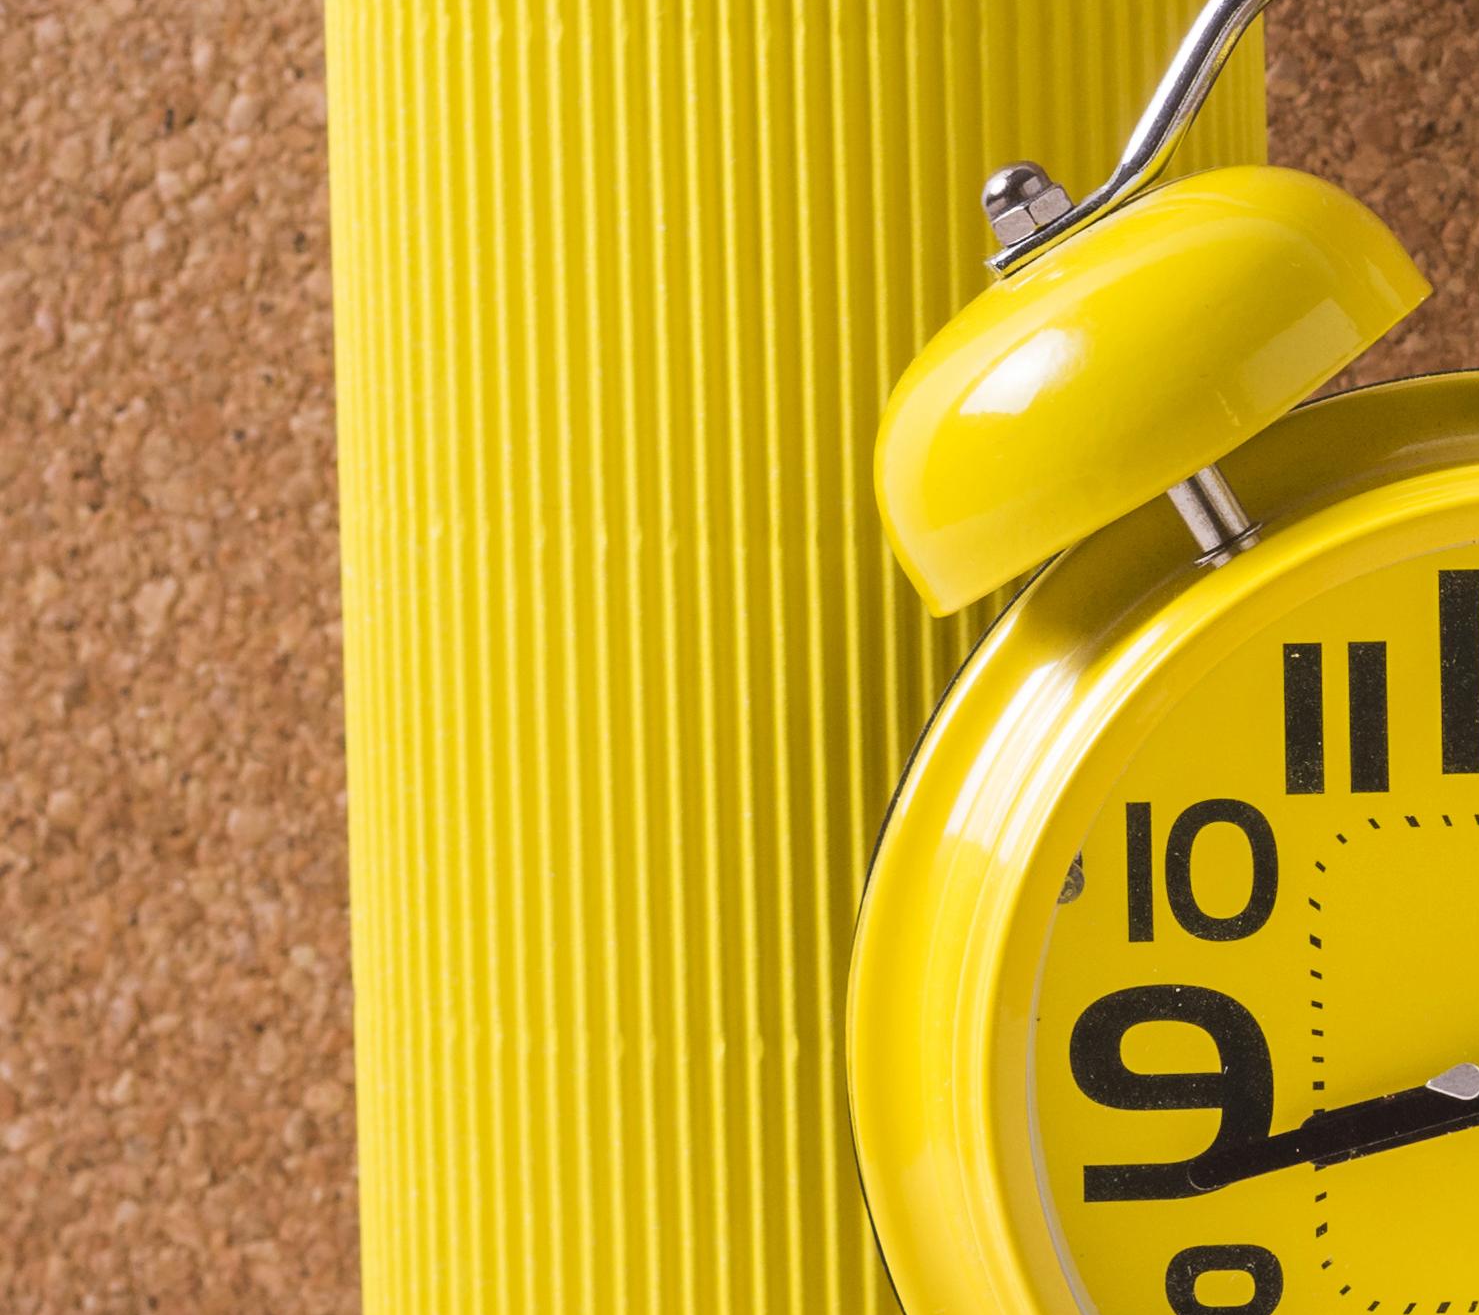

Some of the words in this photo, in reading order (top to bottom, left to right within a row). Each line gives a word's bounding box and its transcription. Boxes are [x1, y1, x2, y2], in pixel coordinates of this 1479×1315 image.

[1282, 641, 1390, 795] 11
[1125, 798, 1280, 943] 10
[1068, 984, 1275, 1204] 9
